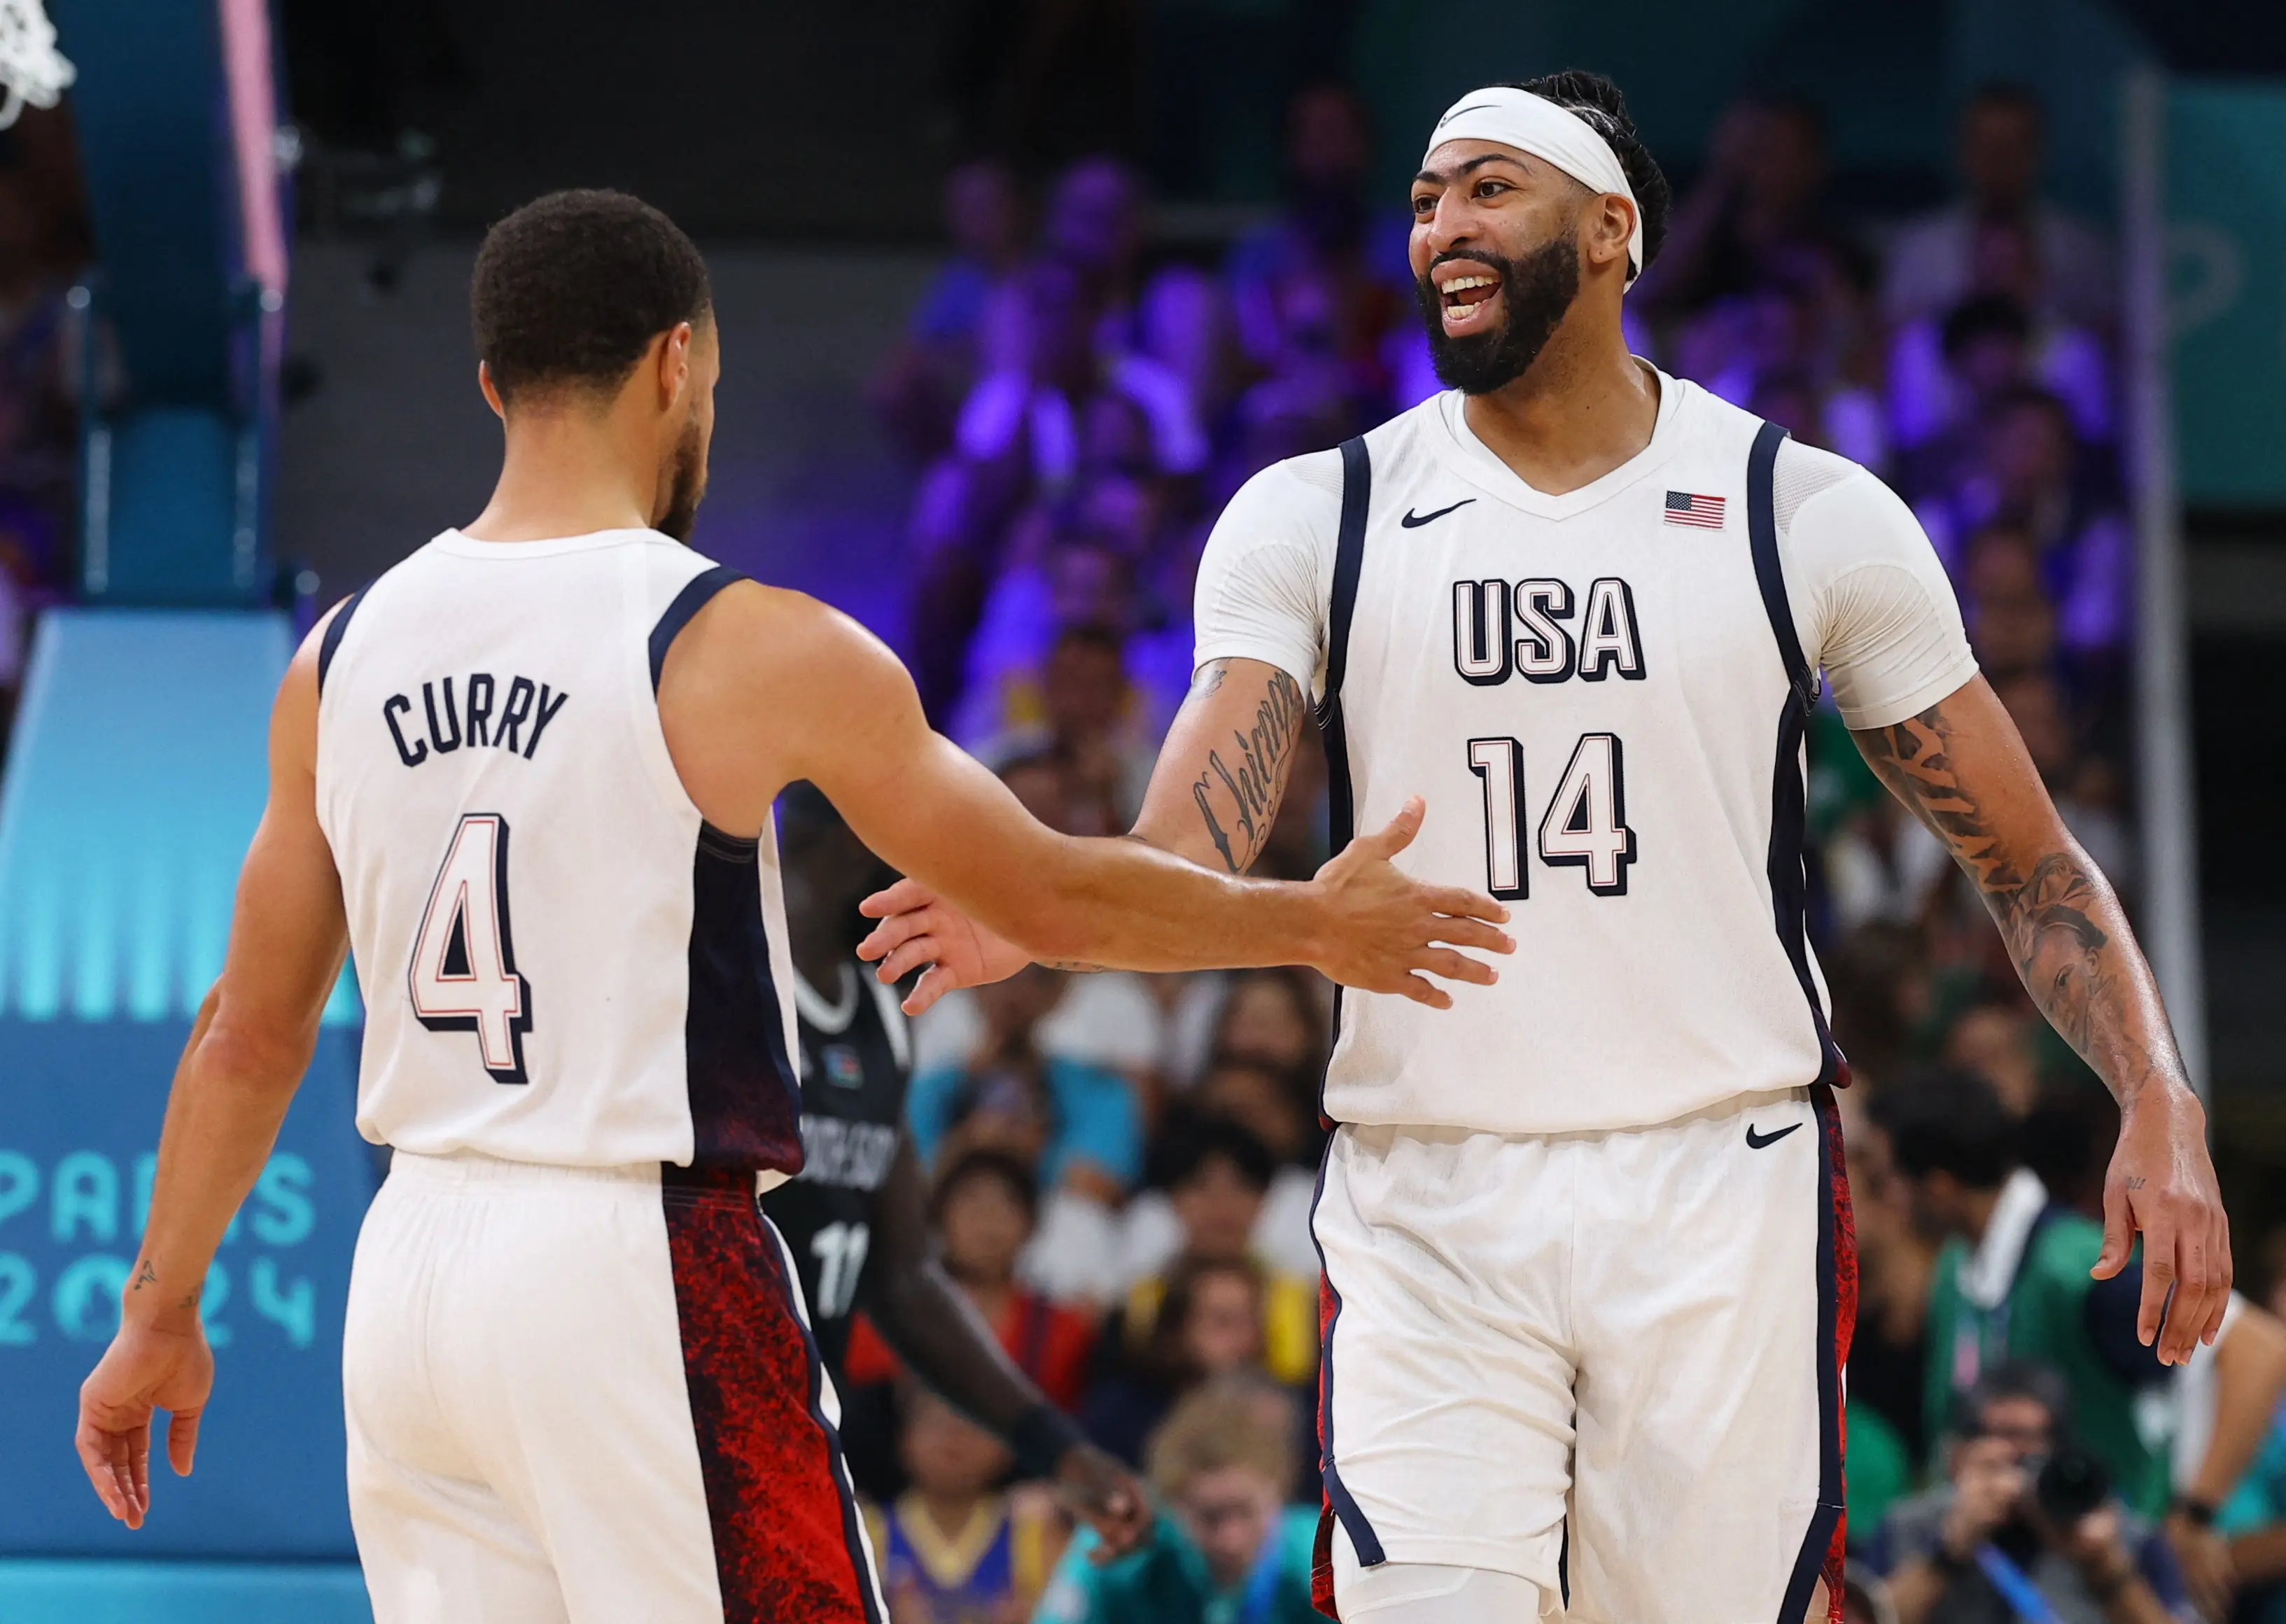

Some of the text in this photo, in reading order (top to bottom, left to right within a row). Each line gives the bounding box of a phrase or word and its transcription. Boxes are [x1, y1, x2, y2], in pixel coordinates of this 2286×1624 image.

[1452, 577, 1647, 686] USA
[383, 673, 569, 768] CURRY
[1467, 732, 1638, 900] 14
[408, 813, 533, 1084] 4
[0, 1149, 314, 1246] PAS
